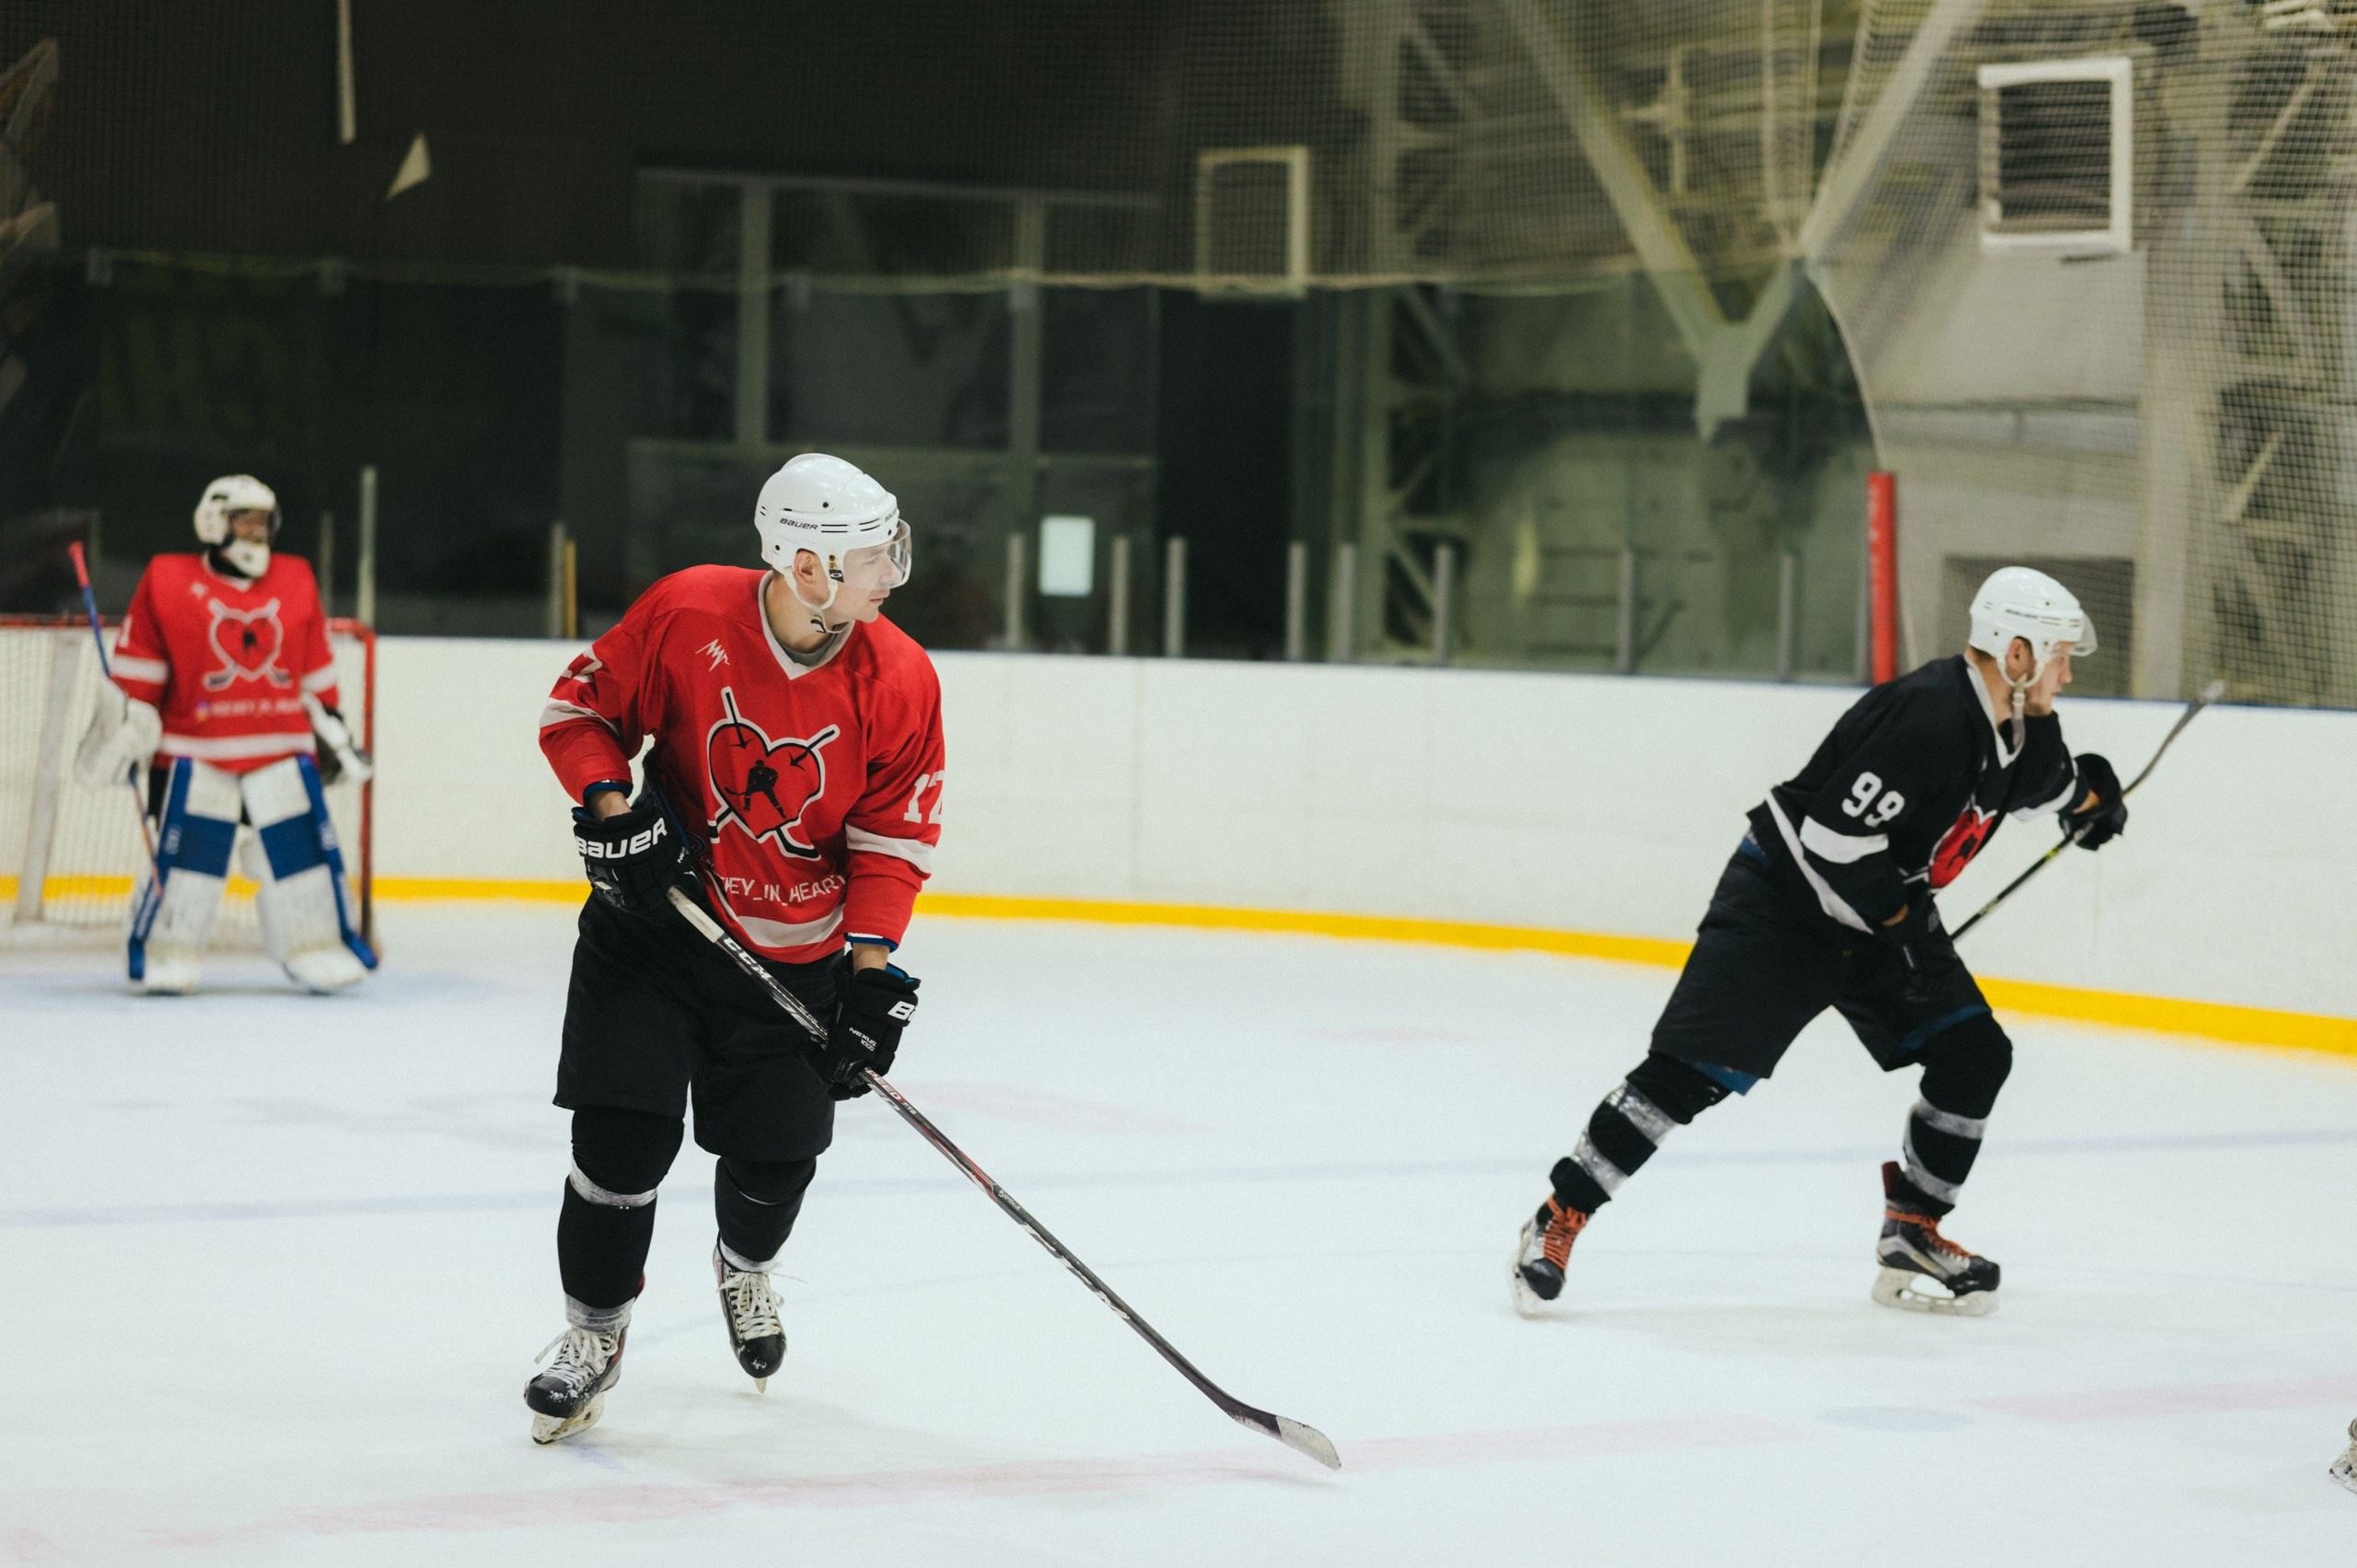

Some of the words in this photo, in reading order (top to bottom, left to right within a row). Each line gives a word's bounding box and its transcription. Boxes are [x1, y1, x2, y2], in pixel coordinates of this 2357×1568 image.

[779, 517, 819, 530] BAUER
[1841, 771, 1905, 828] 99
[575, 817, 668, 859] BAUER
[724, 936, 773, 981] CCM
[888, 1000, 917, 1022] B
[849, 1027, 877, 1047] NEXUS
[865, 1066, 902, 1101] PEED
